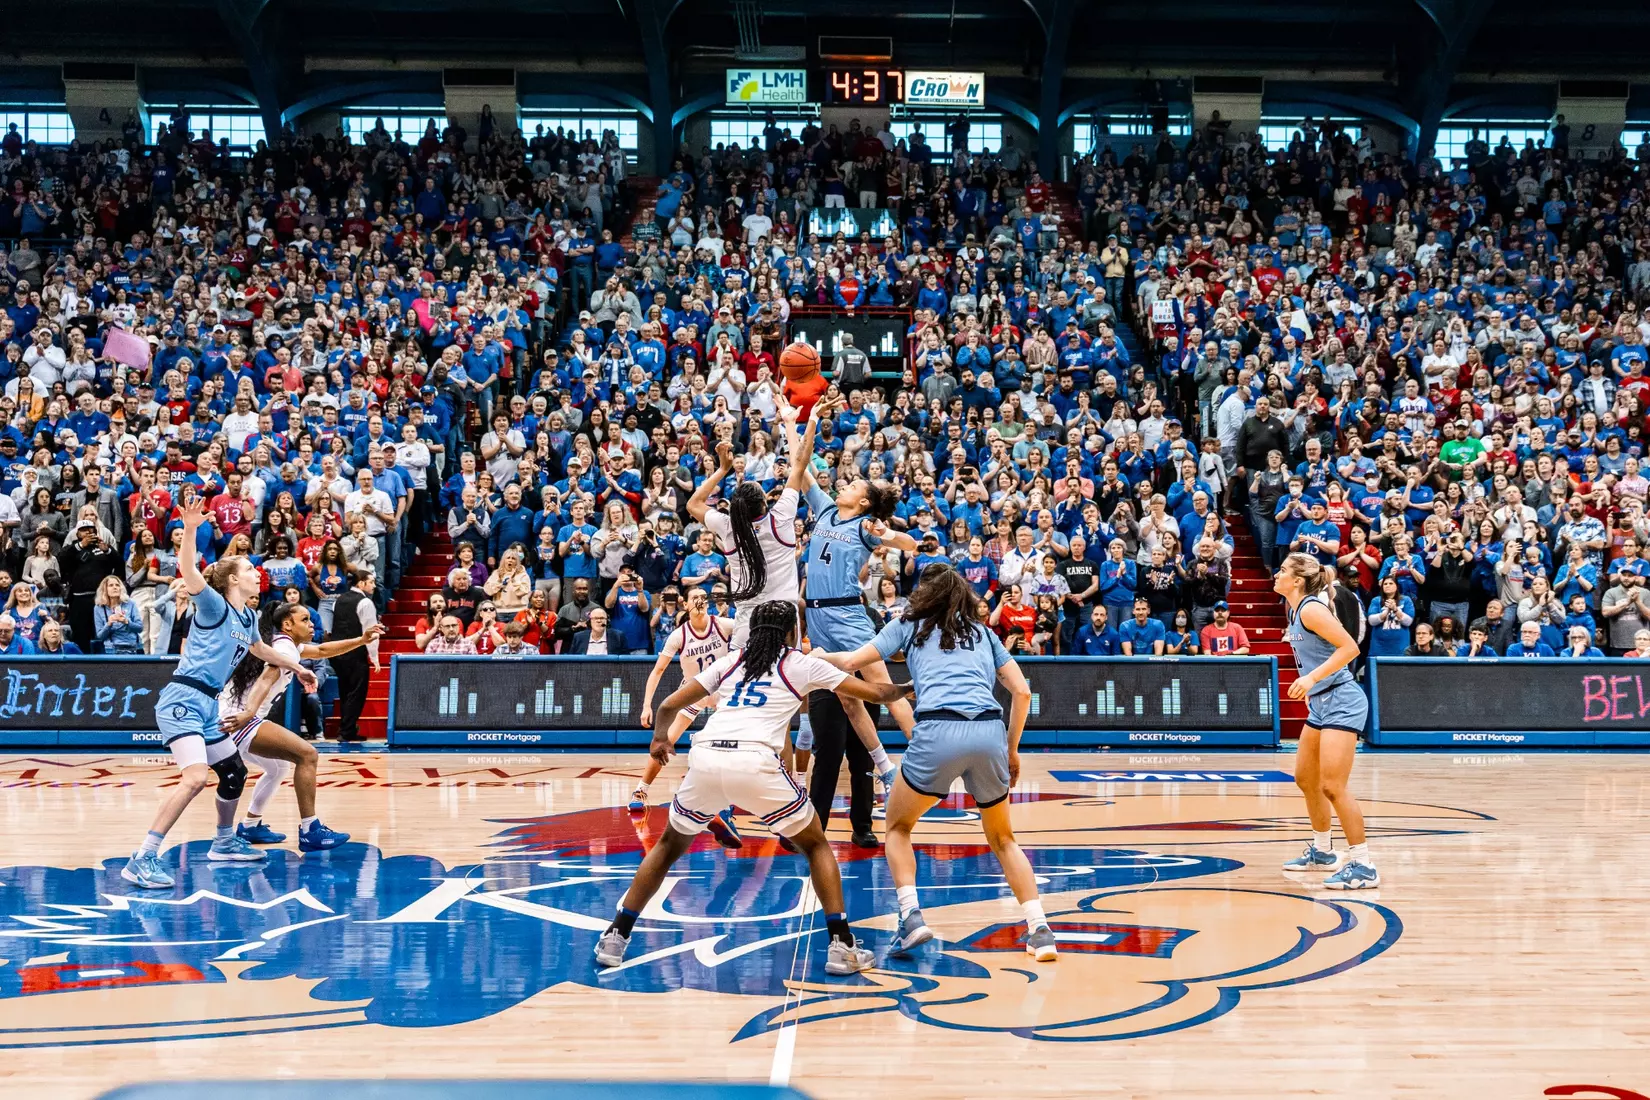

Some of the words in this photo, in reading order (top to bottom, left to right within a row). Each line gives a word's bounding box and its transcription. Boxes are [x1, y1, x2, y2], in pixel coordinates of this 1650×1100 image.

[762, 72, 804, 88] LMH
[832, 71, 903, 102] 4:37
[762, 89, 804, 101] Health
[1582, 124, 1595, 141] 8
[230, 254, 245, 263] 25
[222, 508, 242, 524] 13
[819, 541, 832, 567] 4
[1066, 566, 1093, 576] KANSAS
[686, 639, 722, 658] JAYHAWKS
[1219, 640, 1228, 649] K
[0, 668, 152, 719] Enter
[726, 681, 772, 708] 15
[132, 733, 162, 741] ROCKE
[467, 733, 503, 741] ROCKET
[503, 733, 542, 742] Mortgage
[1129, 733, 1163, 741] ROCKET
[1164, 733, 1202, 742] Mortgage
[1453, 733, 1487, 741] ROCKET
[1488, 733, 1525, 742] Mortgage
[1078, 773, 1265, 781] WNIT
[378, 876, 860, 932] KU
